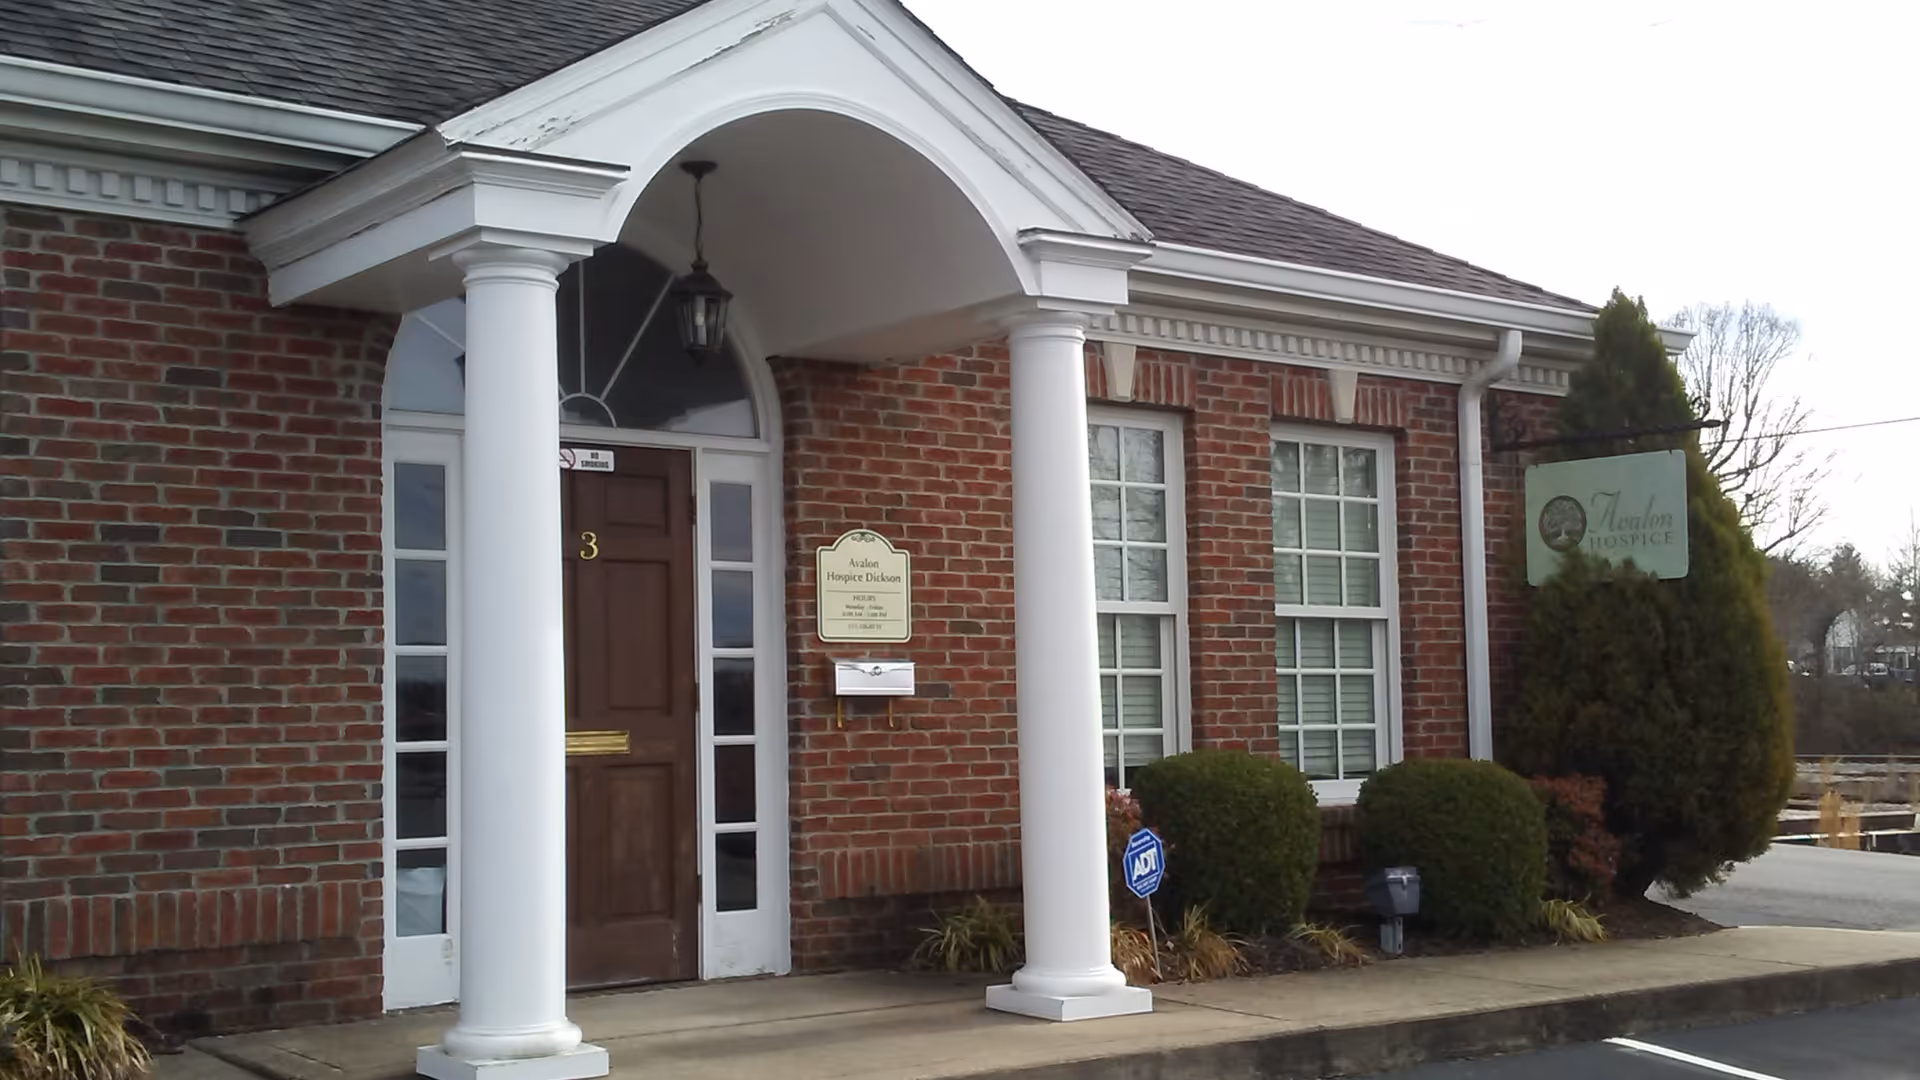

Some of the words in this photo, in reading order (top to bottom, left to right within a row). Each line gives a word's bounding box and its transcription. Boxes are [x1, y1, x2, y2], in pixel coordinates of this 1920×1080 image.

[580, 531, 599, 560] 3
[1589, 531, 1674, 550] HOSPICE
[849, 558, 880, 569] Avalon
[826, 571, 864, 585] Hospice
[865, 572, 902, 583] Dickson
[1133, 847, 1157, 881] ADT
